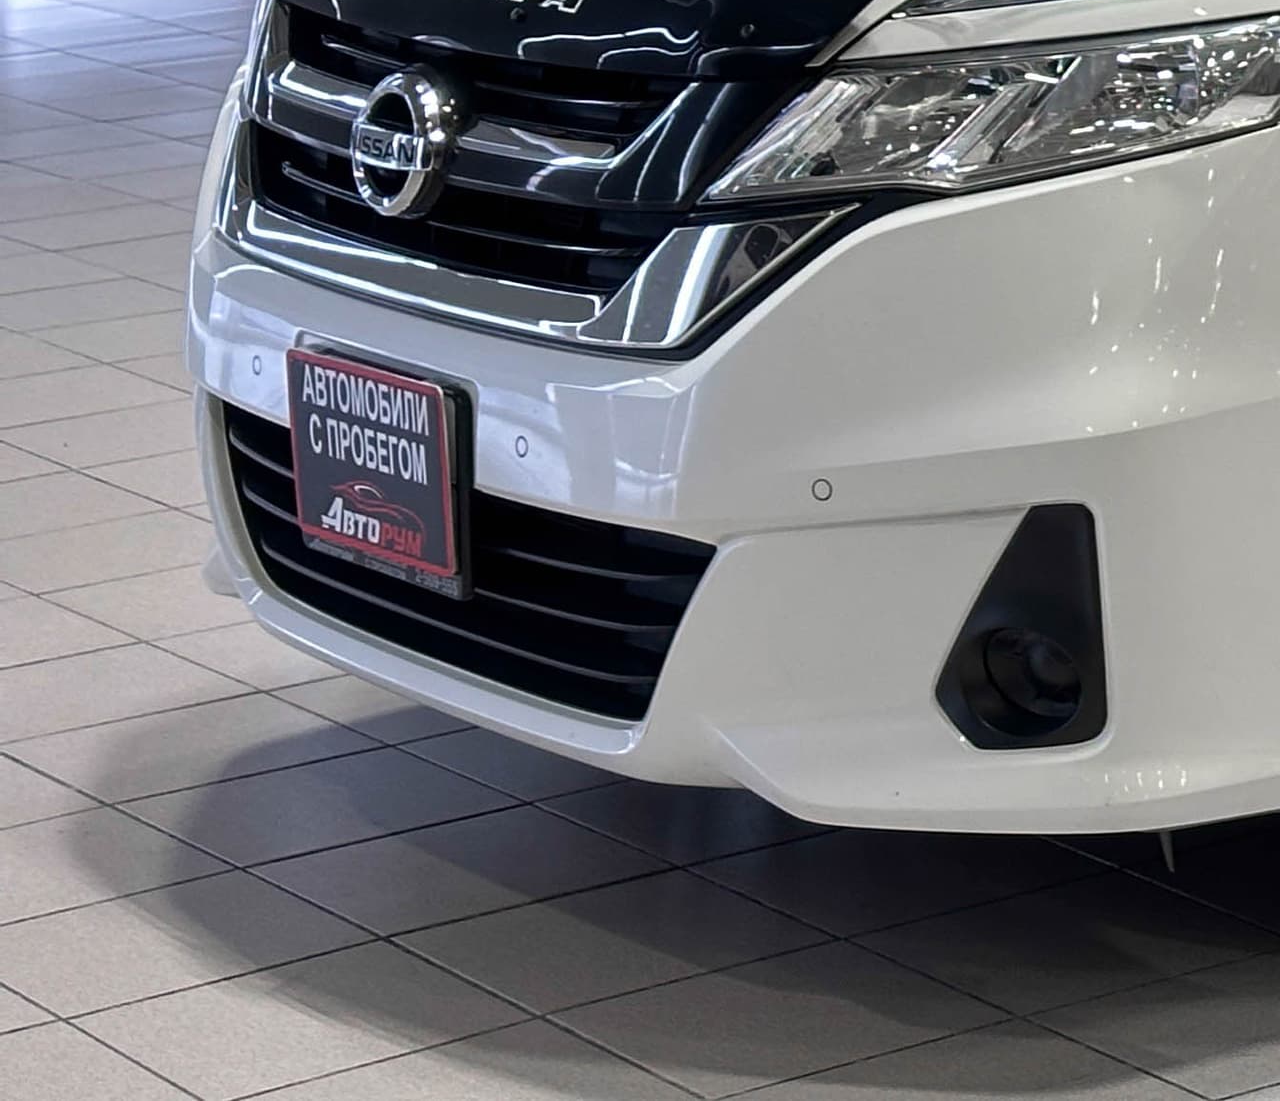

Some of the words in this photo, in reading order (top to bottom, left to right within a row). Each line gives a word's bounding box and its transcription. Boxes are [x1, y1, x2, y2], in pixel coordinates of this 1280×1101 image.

[356, 134, 416, 163] SSAN
[303, 364, 429, 436] АВТОМОБИЛИ
[309, 413, 323, 454] С
[326, 418, 428, 485] ПРОБЕГОМ
